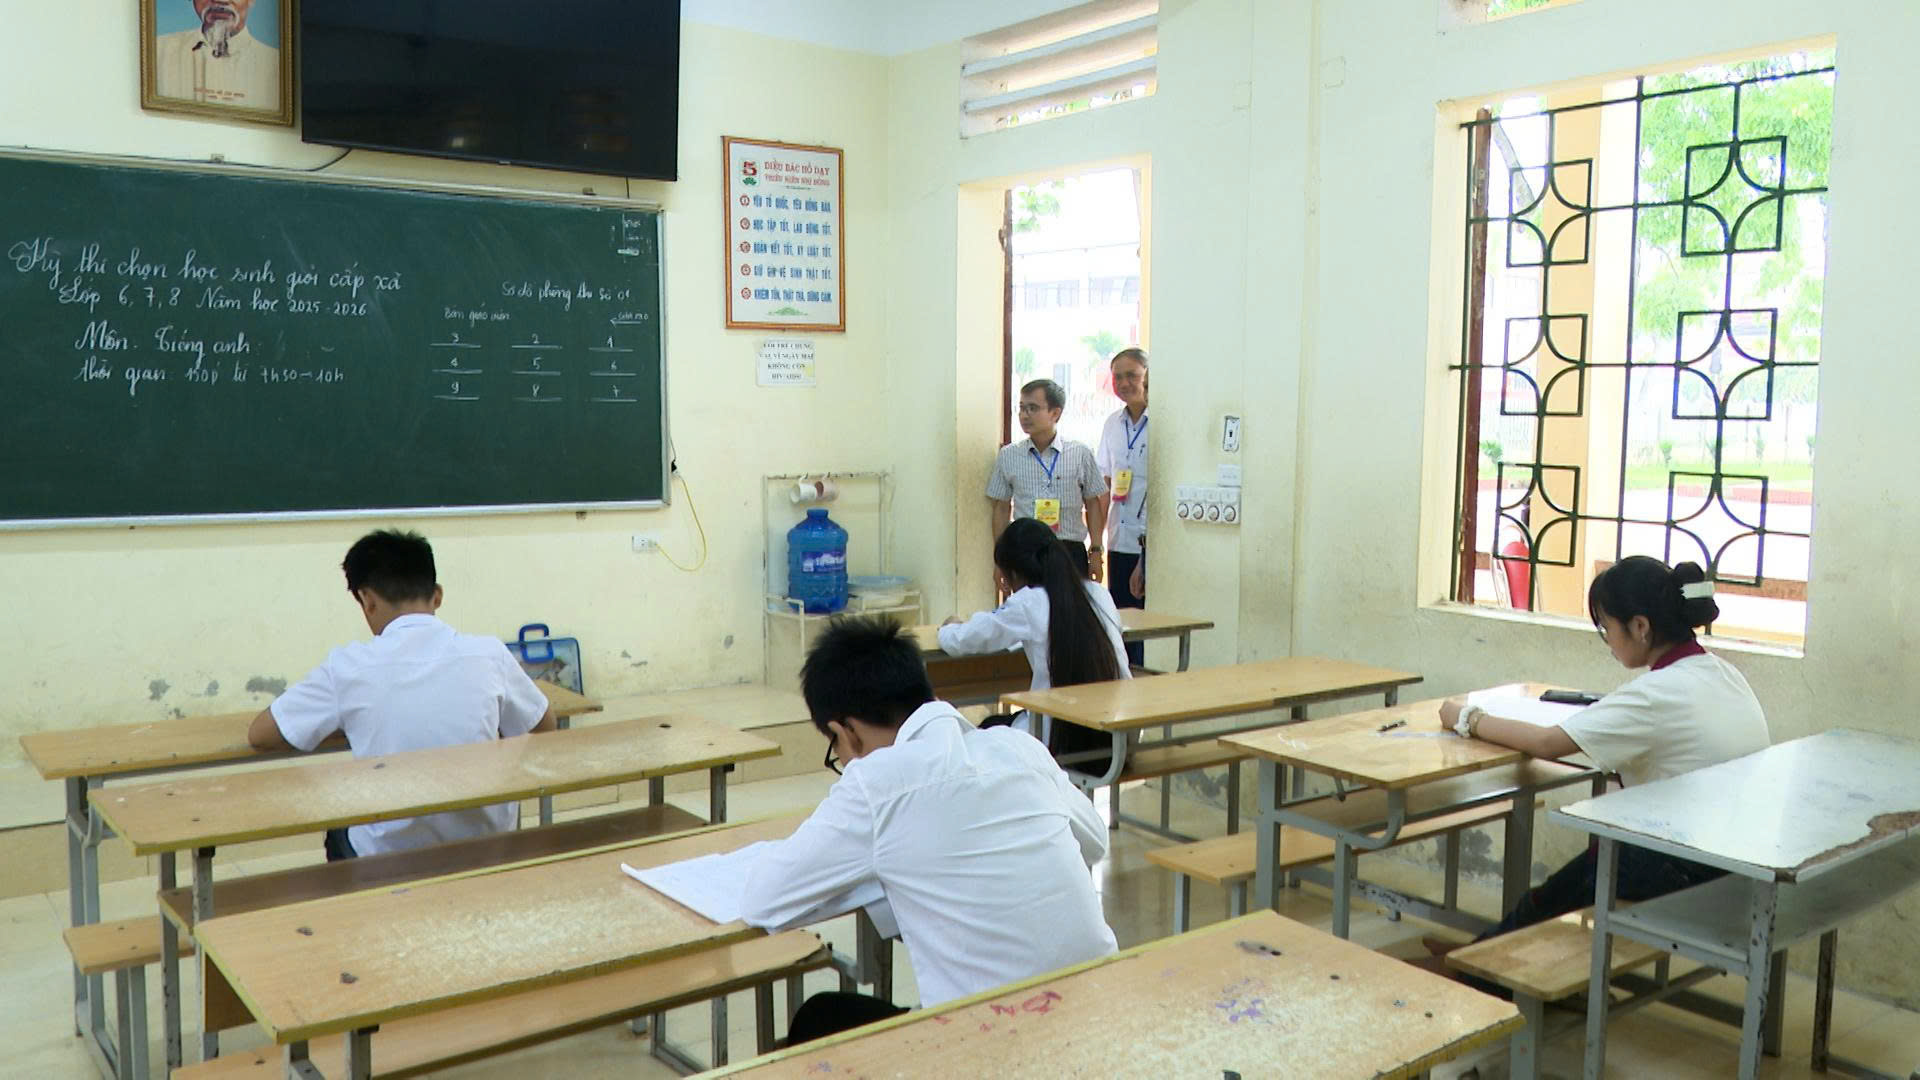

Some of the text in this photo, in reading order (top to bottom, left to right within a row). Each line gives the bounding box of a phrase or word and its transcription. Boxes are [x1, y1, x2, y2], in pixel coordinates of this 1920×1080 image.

[743, 161, 757, 176] 5
[73, 243, 106, 274] thi
[117, 248, 168, 281] chọn
[177, 249, 219, 284] học
[231, 259, 276, 285] sinh
[329, 261, 365, 299] cấp
[59, 275, 101, 314] Lớp
[168, 287, 182, 307] 8
[196, 286, 242, 311] Năm
[251, 288, 280, 315] học
[155, 325, 206, 369] Tiếng
[532, 355, 541, 370] 5
[451, 381, 460, 394] 9
[531, 383, 540, 397] 8
